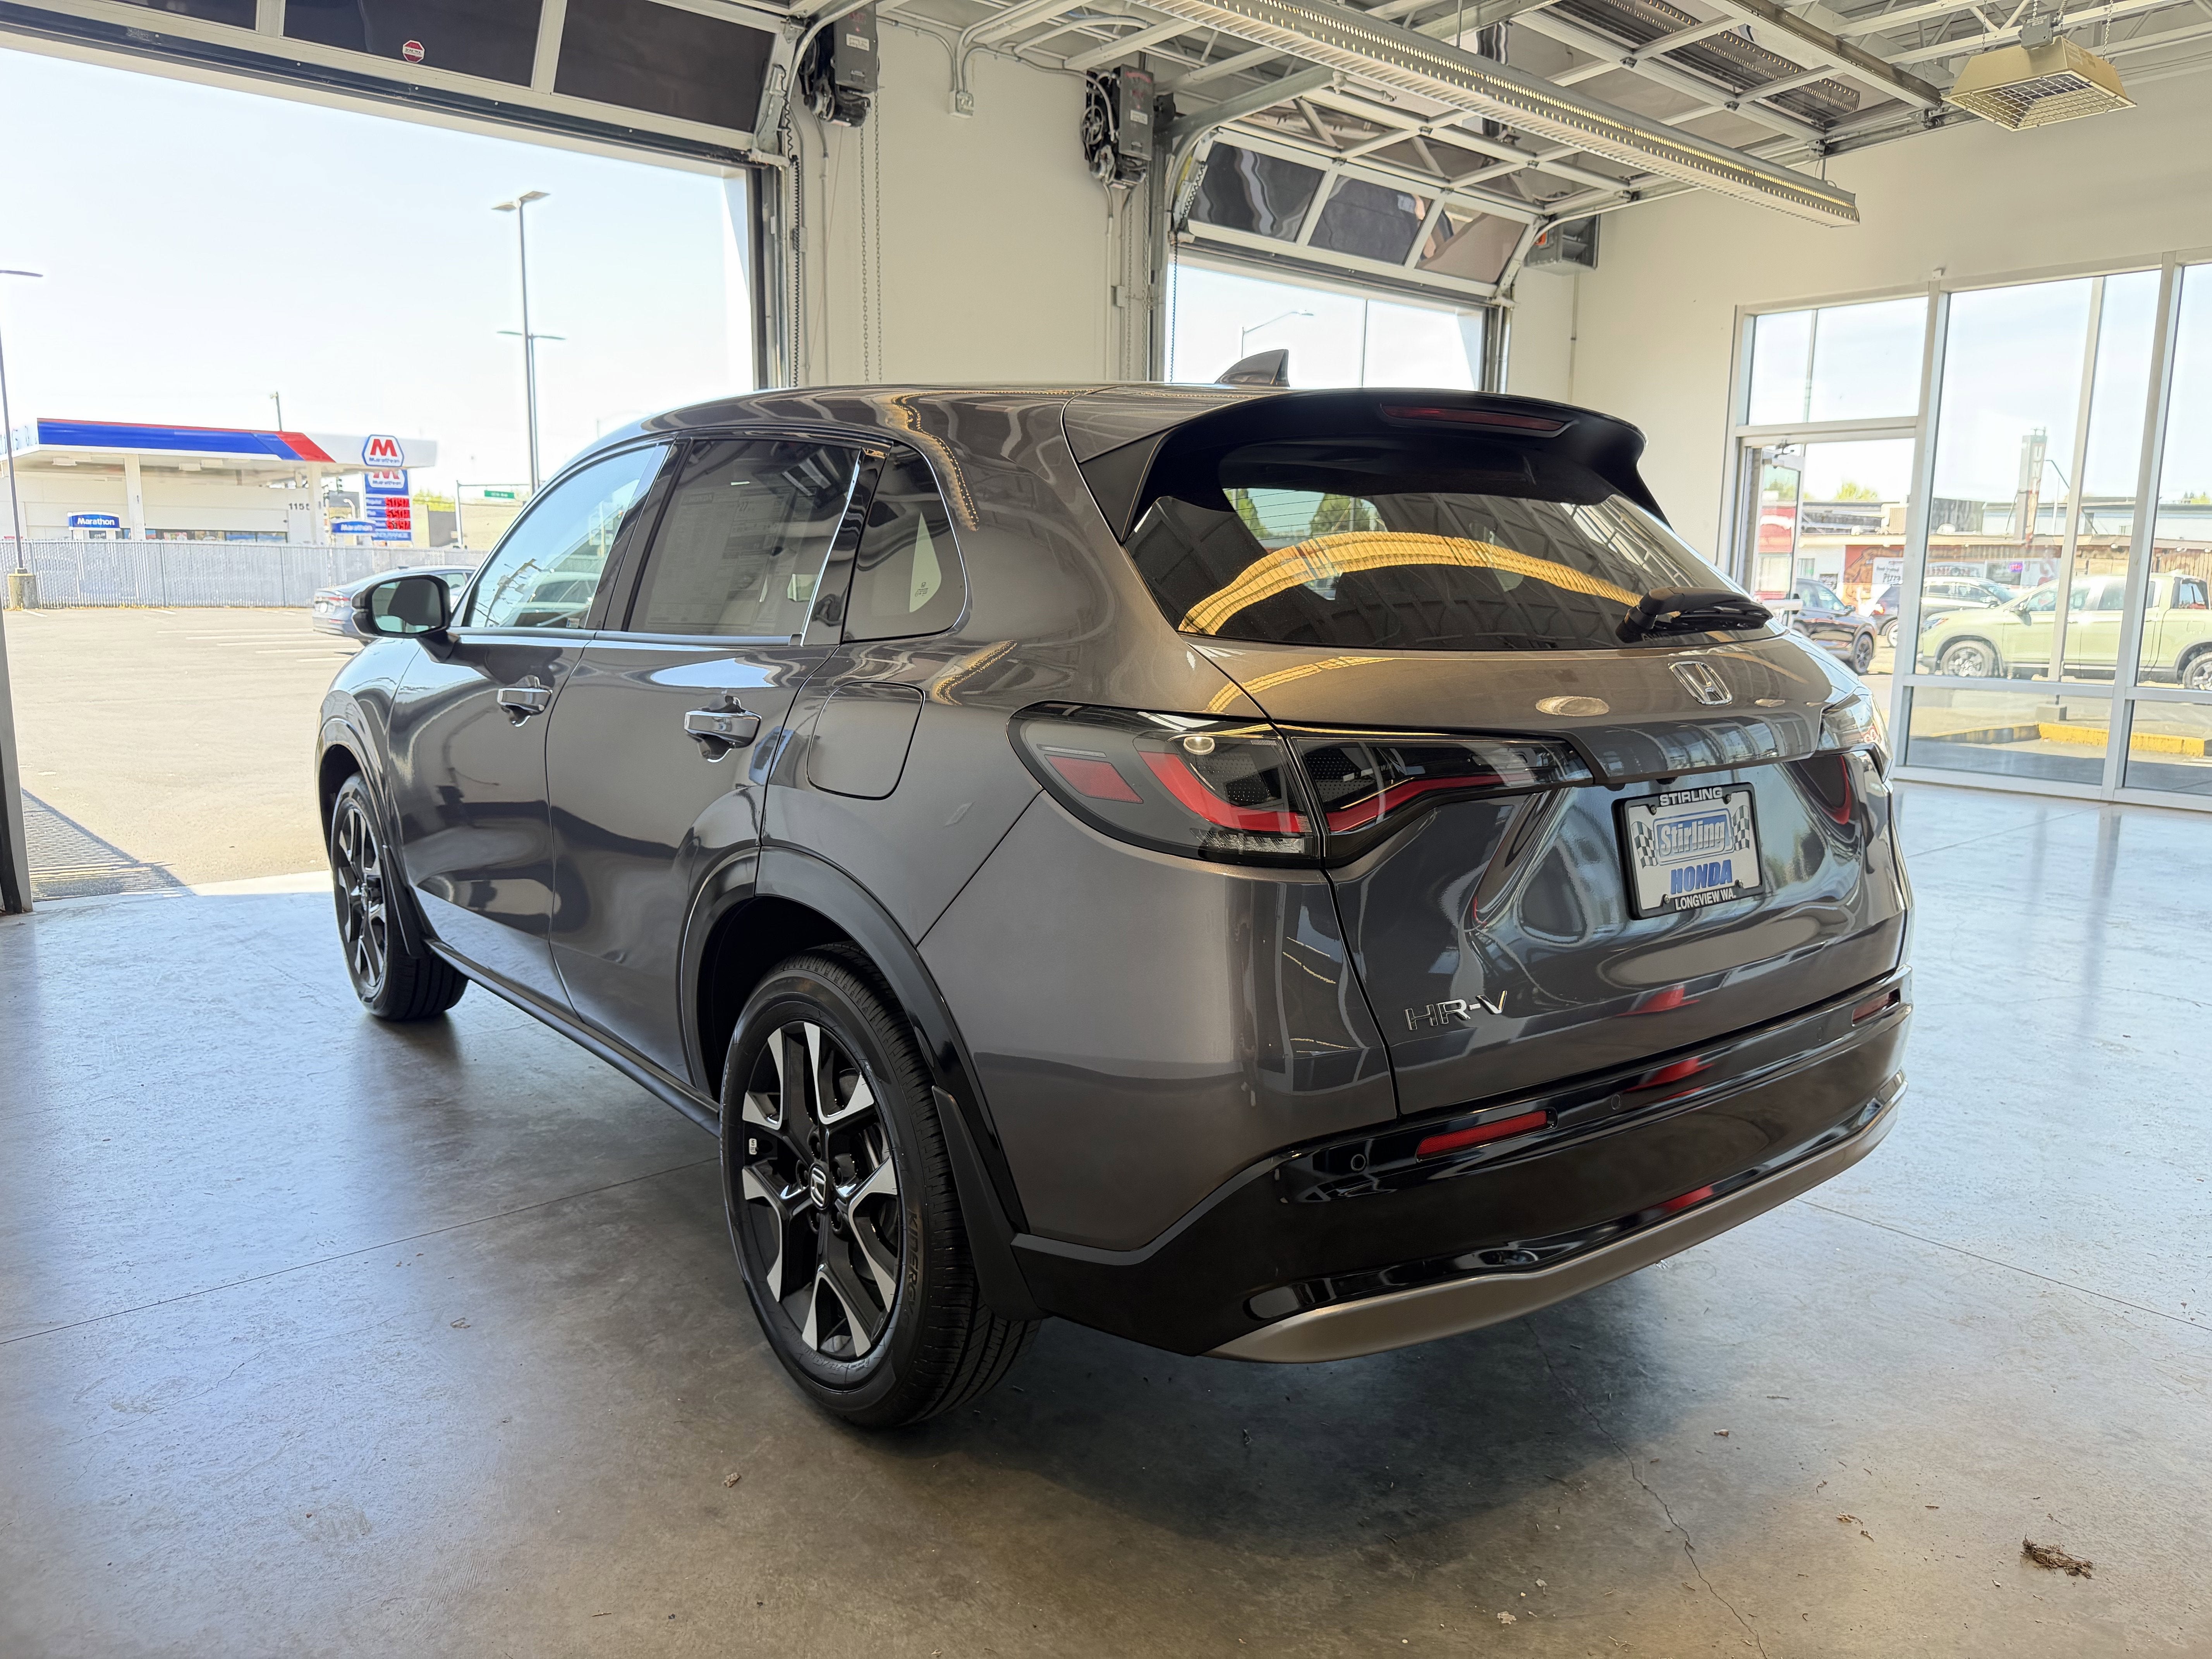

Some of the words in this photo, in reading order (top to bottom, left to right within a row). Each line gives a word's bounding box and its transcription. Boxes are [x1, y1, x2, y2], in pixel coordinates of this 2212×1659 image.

[370, 439, 397, 457] M
[77, 517, 115, 526] Marathon
[1659, 787, 1723, 806] STIRLING
[1660, 820, 1725, 855] Stirling
[1670, 859, 1733, 895] HONDA
[1674, 890, 1721, 910] LONGVIEW
[1721, 888, 1736, 901] WA.
[1404, 989, 1508, 1031] HR-V
